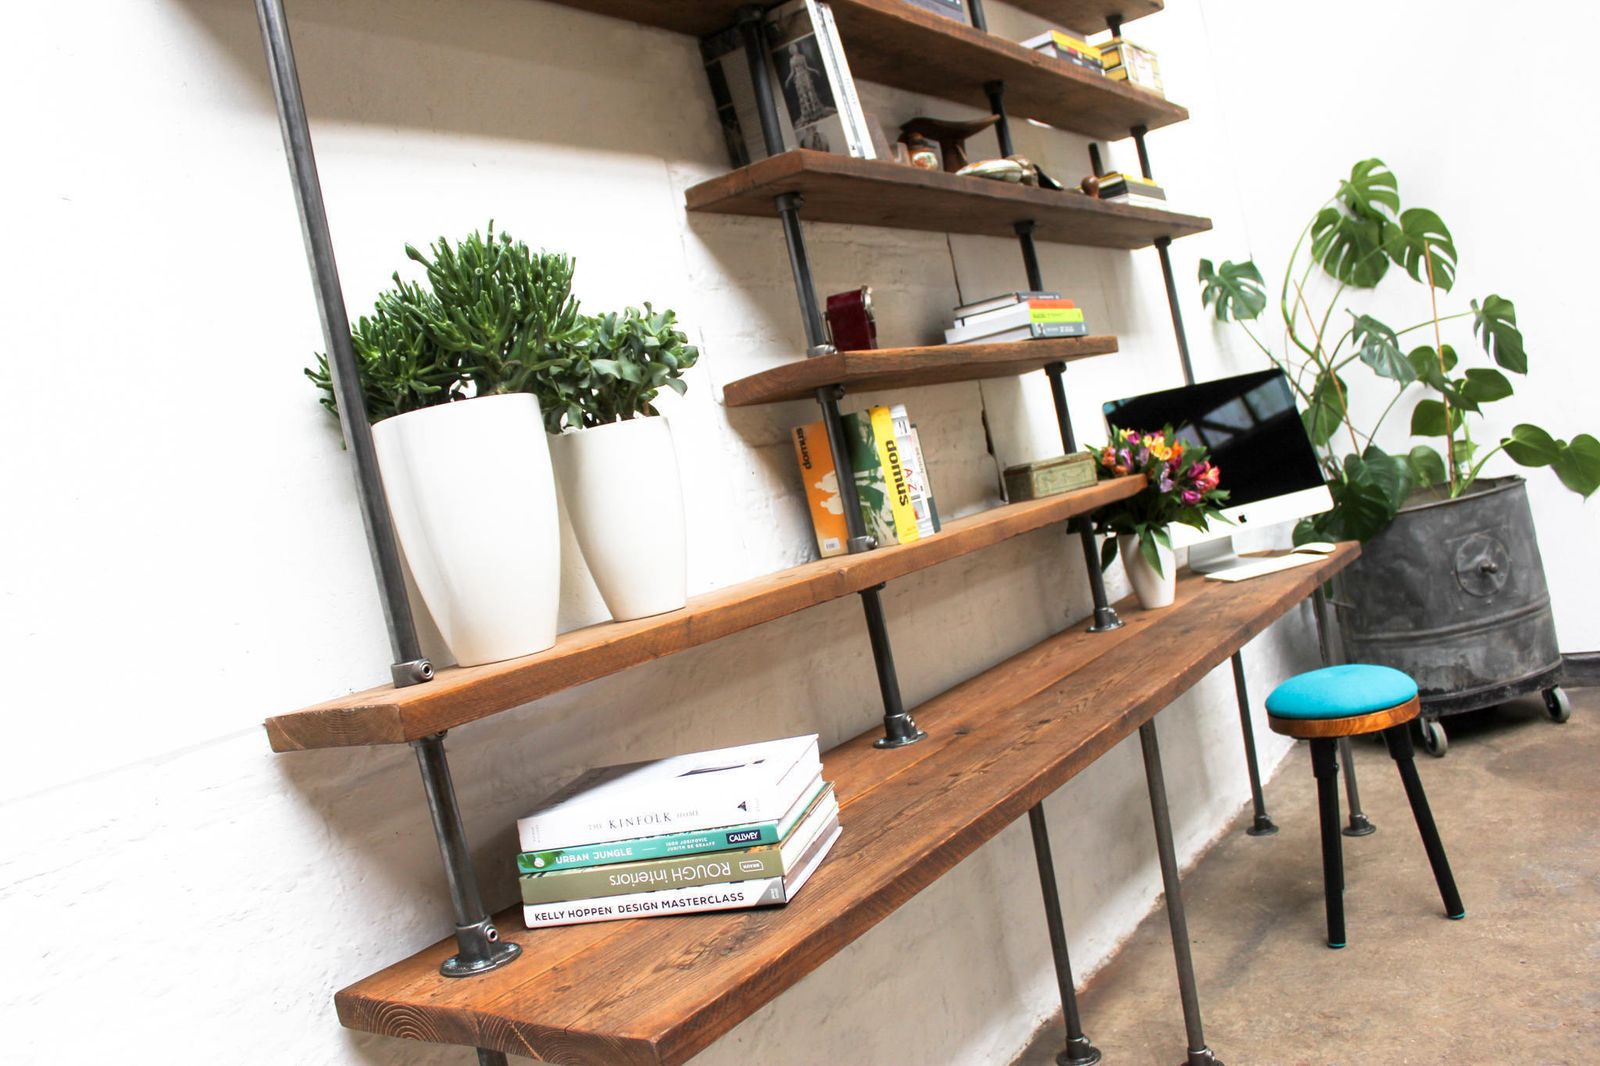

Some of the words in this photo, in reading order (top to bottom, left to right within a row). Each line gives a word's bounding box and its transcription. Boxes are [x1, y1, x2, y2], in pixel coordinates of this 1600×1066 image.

[886, 440, 909, 507] domus
[608, 812, 671, 829] KINFOLK
[728, 831, 758, 842] CALLWEY
[555, 853, 589, 864] URBAN
[593, 848, 633, 859] JUNGLE
[609, 868, 669, 887] interiors
[672, 862, 731, 882] ROUGH
[535, 911, 565, 921] KELLY
[568, 906, 613, 918] HOPPEN
[618, 902, 658, 913] DESIGN
[662, 892, 744, 909] MASTERCLASS
